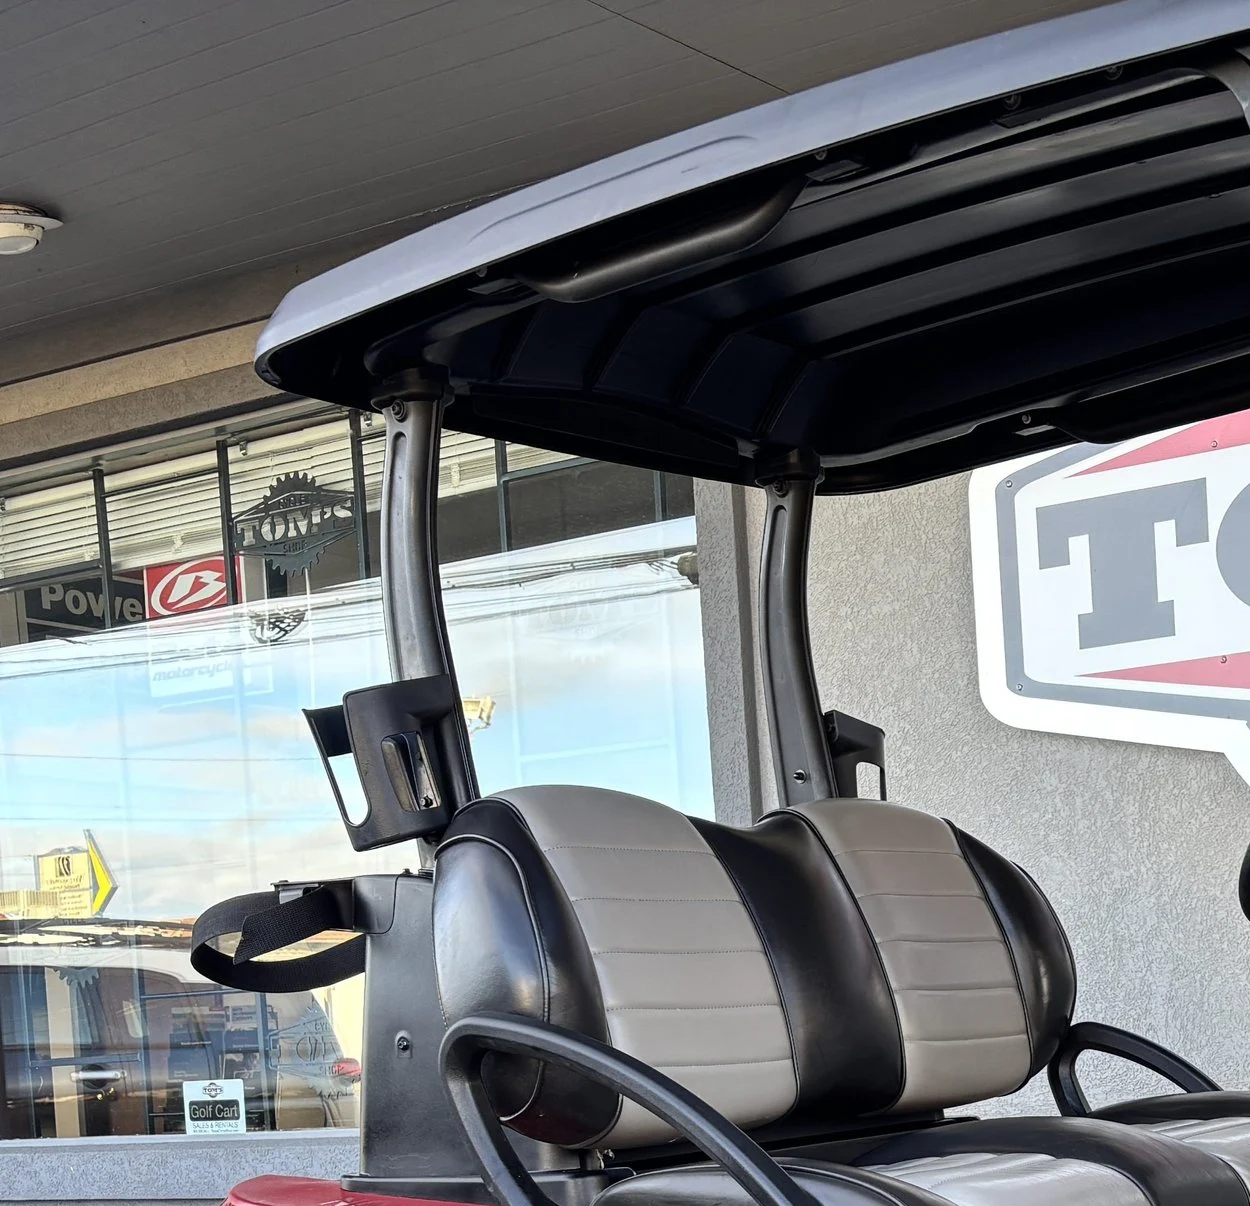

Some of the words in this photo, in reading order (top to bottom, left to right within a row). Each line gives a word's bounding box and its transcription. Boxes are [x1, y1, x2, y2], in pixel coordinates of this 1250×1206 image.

[41, 584, 142, 622] Powe
[191, 1105, 212, 1118] Golf
[215, 1104, 238, 1117] Cart
